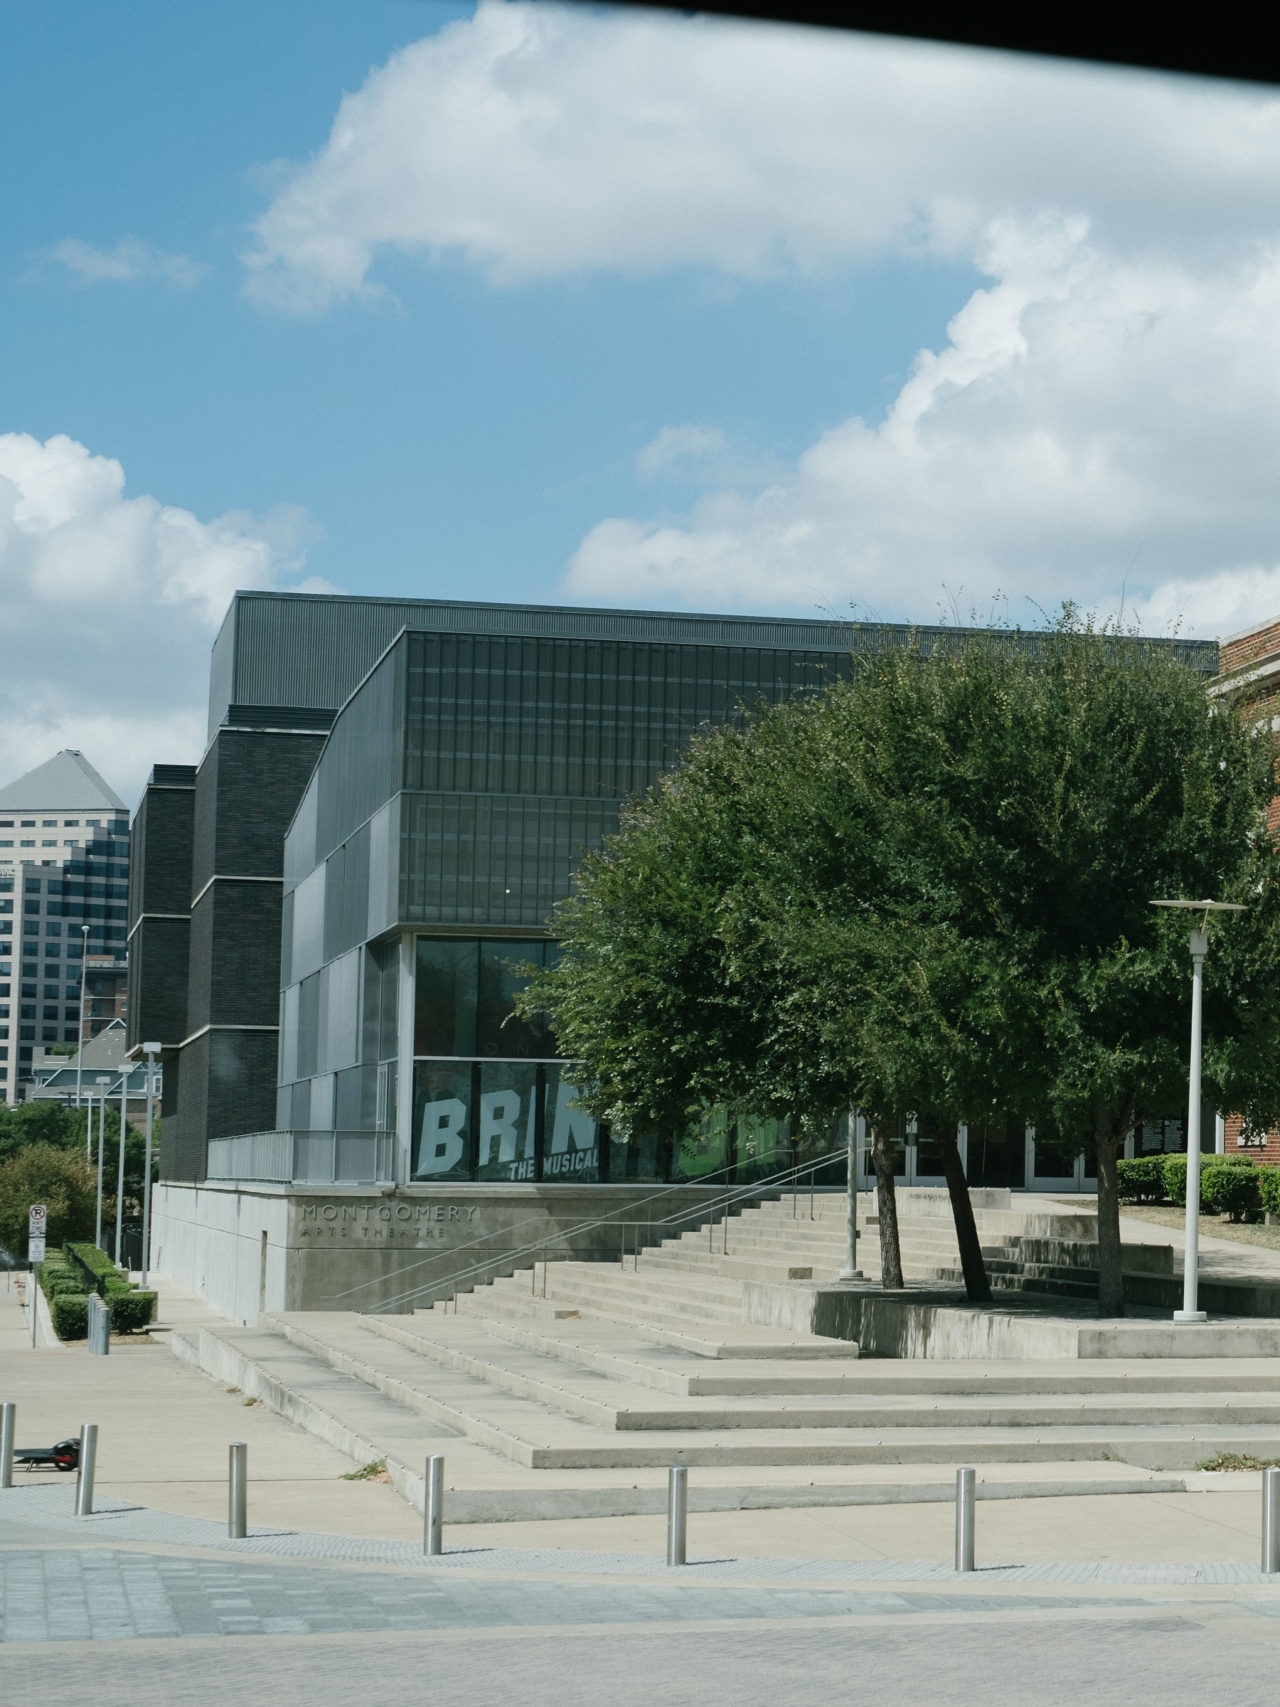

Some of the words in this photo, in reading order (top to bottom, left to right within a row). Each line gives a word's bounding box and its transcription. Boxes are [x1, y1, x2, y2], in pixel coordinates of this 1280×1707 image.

[509, 1160, 535, 1181] THE
[543, 1149, 599, 1175] MUSICAL
[302, 1204, 477, 1222] MONTGOMERY
[302, 1227, 347, 1238] ARTS
[361, 1227, 445, 1239] THEATRE
